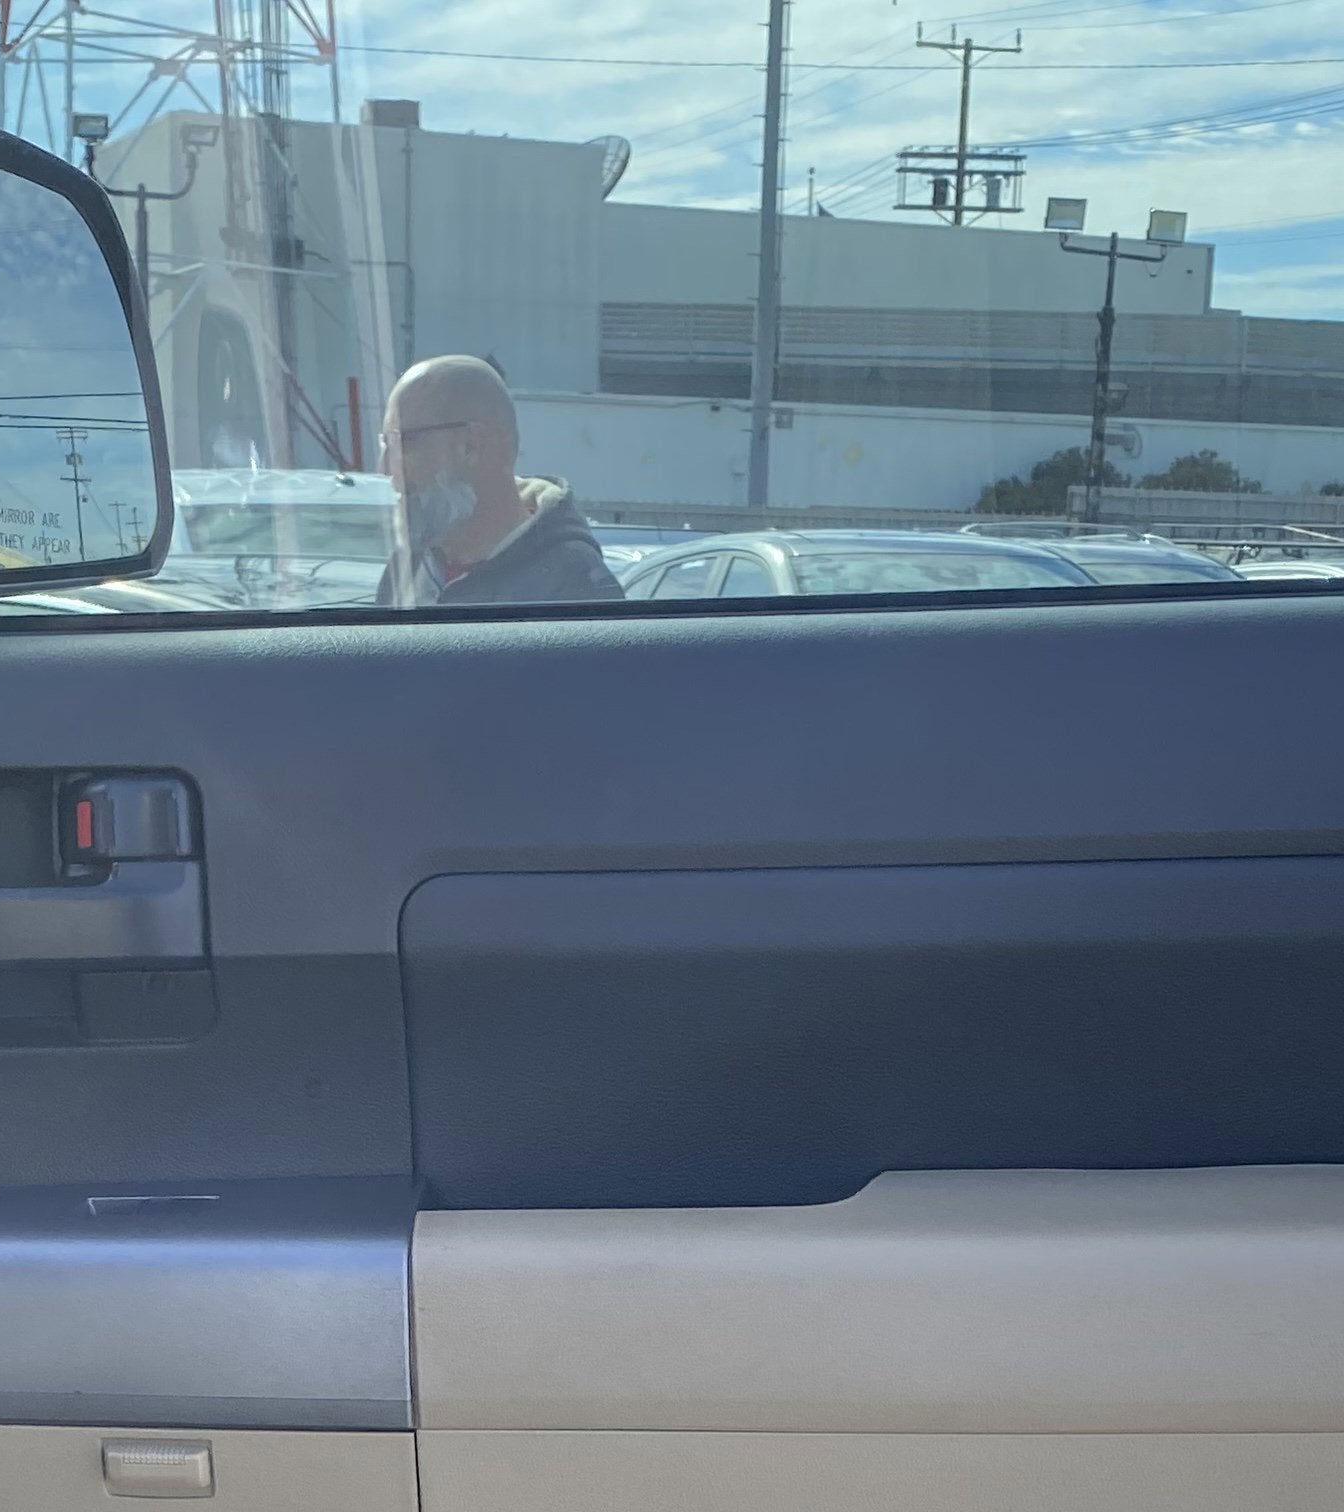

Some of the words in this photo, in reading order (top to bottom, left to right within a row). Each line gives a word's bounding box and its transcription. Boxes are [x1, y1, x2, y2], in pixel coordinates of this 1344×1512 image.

[42, 512, 61, 528] ARE
[0, 532, 25, 549] THEY
[32, 536, 70, 553] APPEAR
